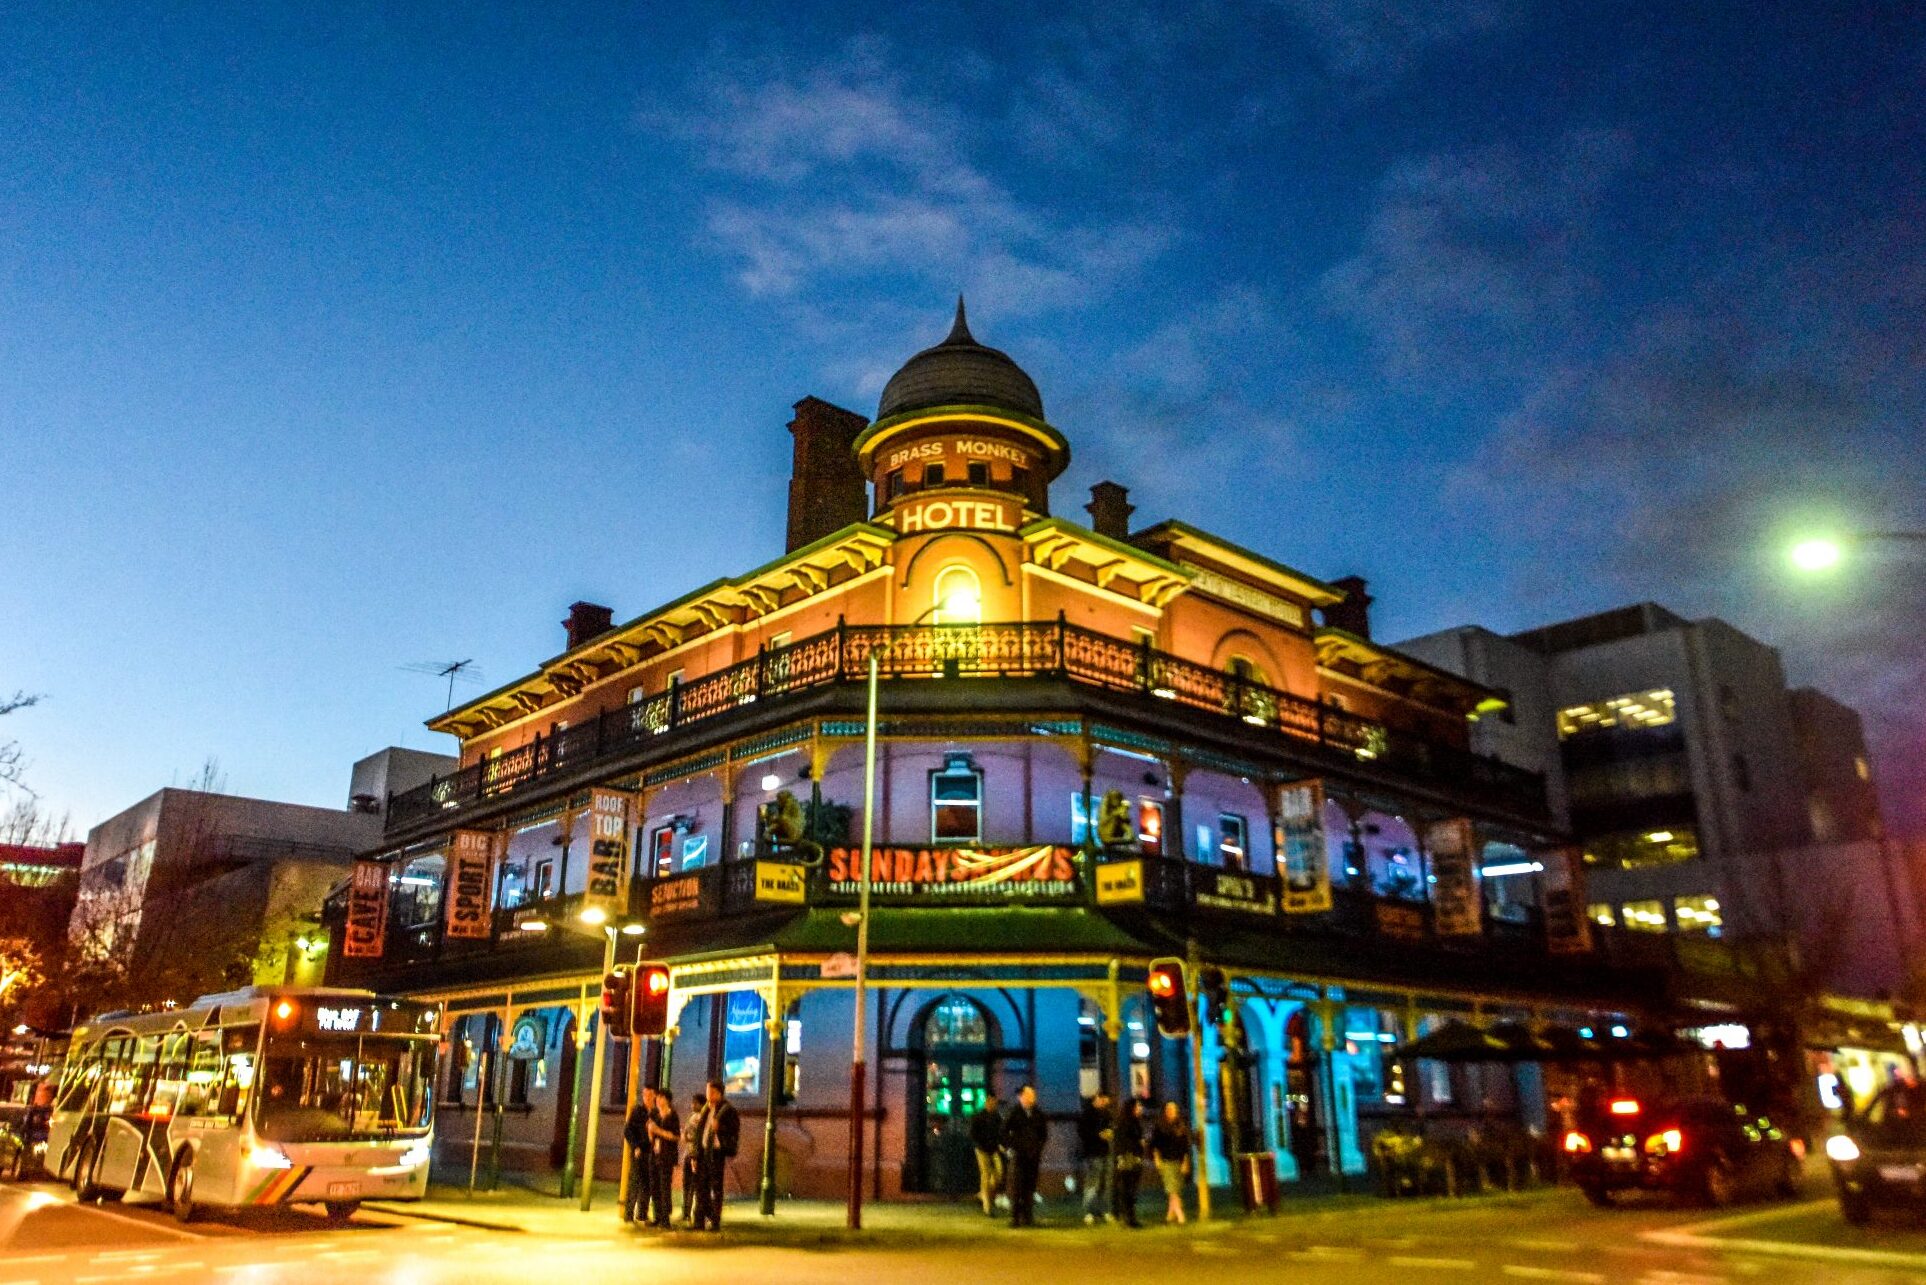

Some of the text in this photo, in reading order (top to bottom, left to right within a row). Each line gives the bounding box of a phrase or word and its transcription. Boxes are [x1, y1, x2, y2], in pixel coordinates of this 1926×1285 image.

[890, 441, 943, 467] BRASS
[902, 501, 1015, 534] HOTEL
[595, 814, 625, 838] TOP
[589, 839, 622, 897] BAR
[454, 859, 485, 922] SPORT
[351, 889, 381, 945] CAVE
